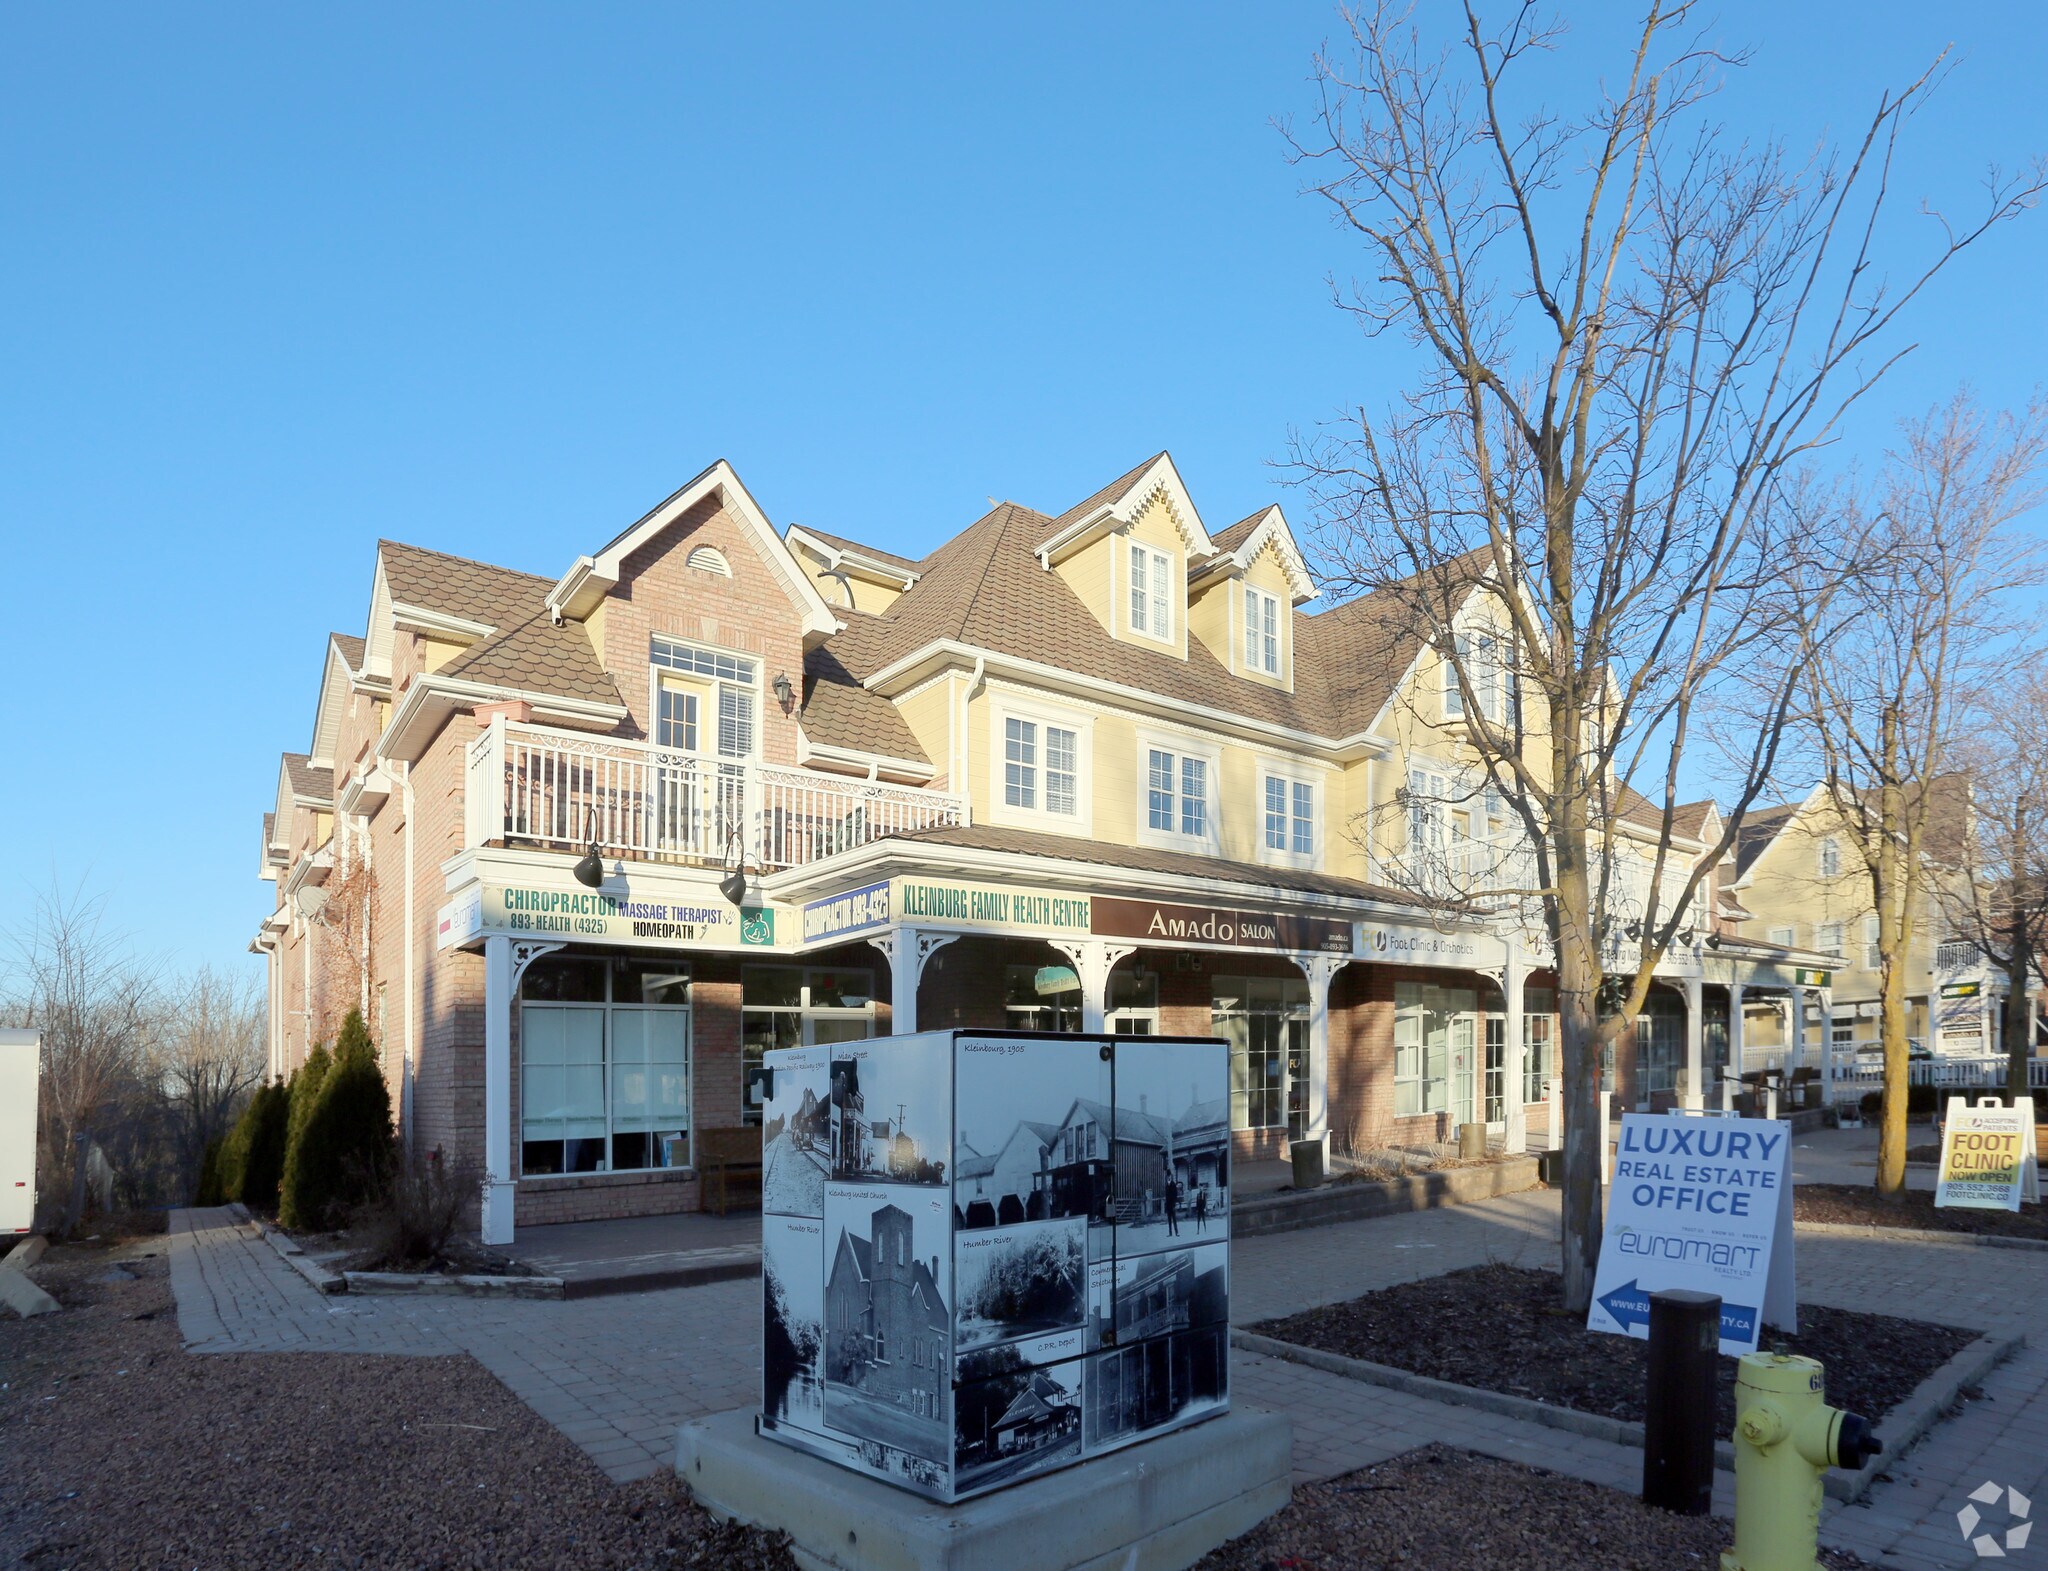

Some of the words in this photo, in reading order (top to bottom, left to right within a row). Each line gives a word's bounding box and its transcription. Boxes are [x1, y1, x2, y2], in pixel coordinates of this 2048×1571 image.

[504, 888, 617, 917] CHIROPRACTOR
[904, 884, 967, 919] KLEINBURG
[971, 890, 1009, 922] FAMILY
[1013, 895, 1050, 925] HEALTH
[1052, 900, 1089, 928] CENTRE
[618, 902, 668, 921] MASSAGE
[671, 905, 722, 924] THERAPIST
[804, 897, 852, 939] CHIROPRACTOR
[852, 887, 889, 927] 893-4325
[510, 913, 571, 932] 893-HEALTH
[574, 917, 608, 934] (4325)
[633, 920, 694, 940] HOMEOPATH
[1240, 923, 1276, 940] SALON
[1390, 936, 1408, 951] Foot
[1410, 938, 1431, 952] Clinic
[1432, 941, 1438, 952] &
[1441, 941, 1474, 955] Orthotics
[1007, 1045, 1025, 1056] 1905
[1623, 1126, 1782, 1161] LUXURY
[1953, 1134, 2016, 1151] FOOT
[1951, 1152, 2013, 1171] CLINIC
[1618, 1161, 1674, 1180] REAL
[1683, 1165, 1776, 1189] ESTATE
[1948, 1171, 1976, 1181] NOW
[1980, 1172, 2012, 1182] OPEN
[1632, 1184, 1752, 1217] OFFICE
[807, 1224, 820, 1234] River
[963, 1235, 992, 1249] Humber
[993, 1234, 1013, 1245] River
[1714, 1266, 1738, 1275] REALTY
[1058, 1337, 1075, 1348] Depot
